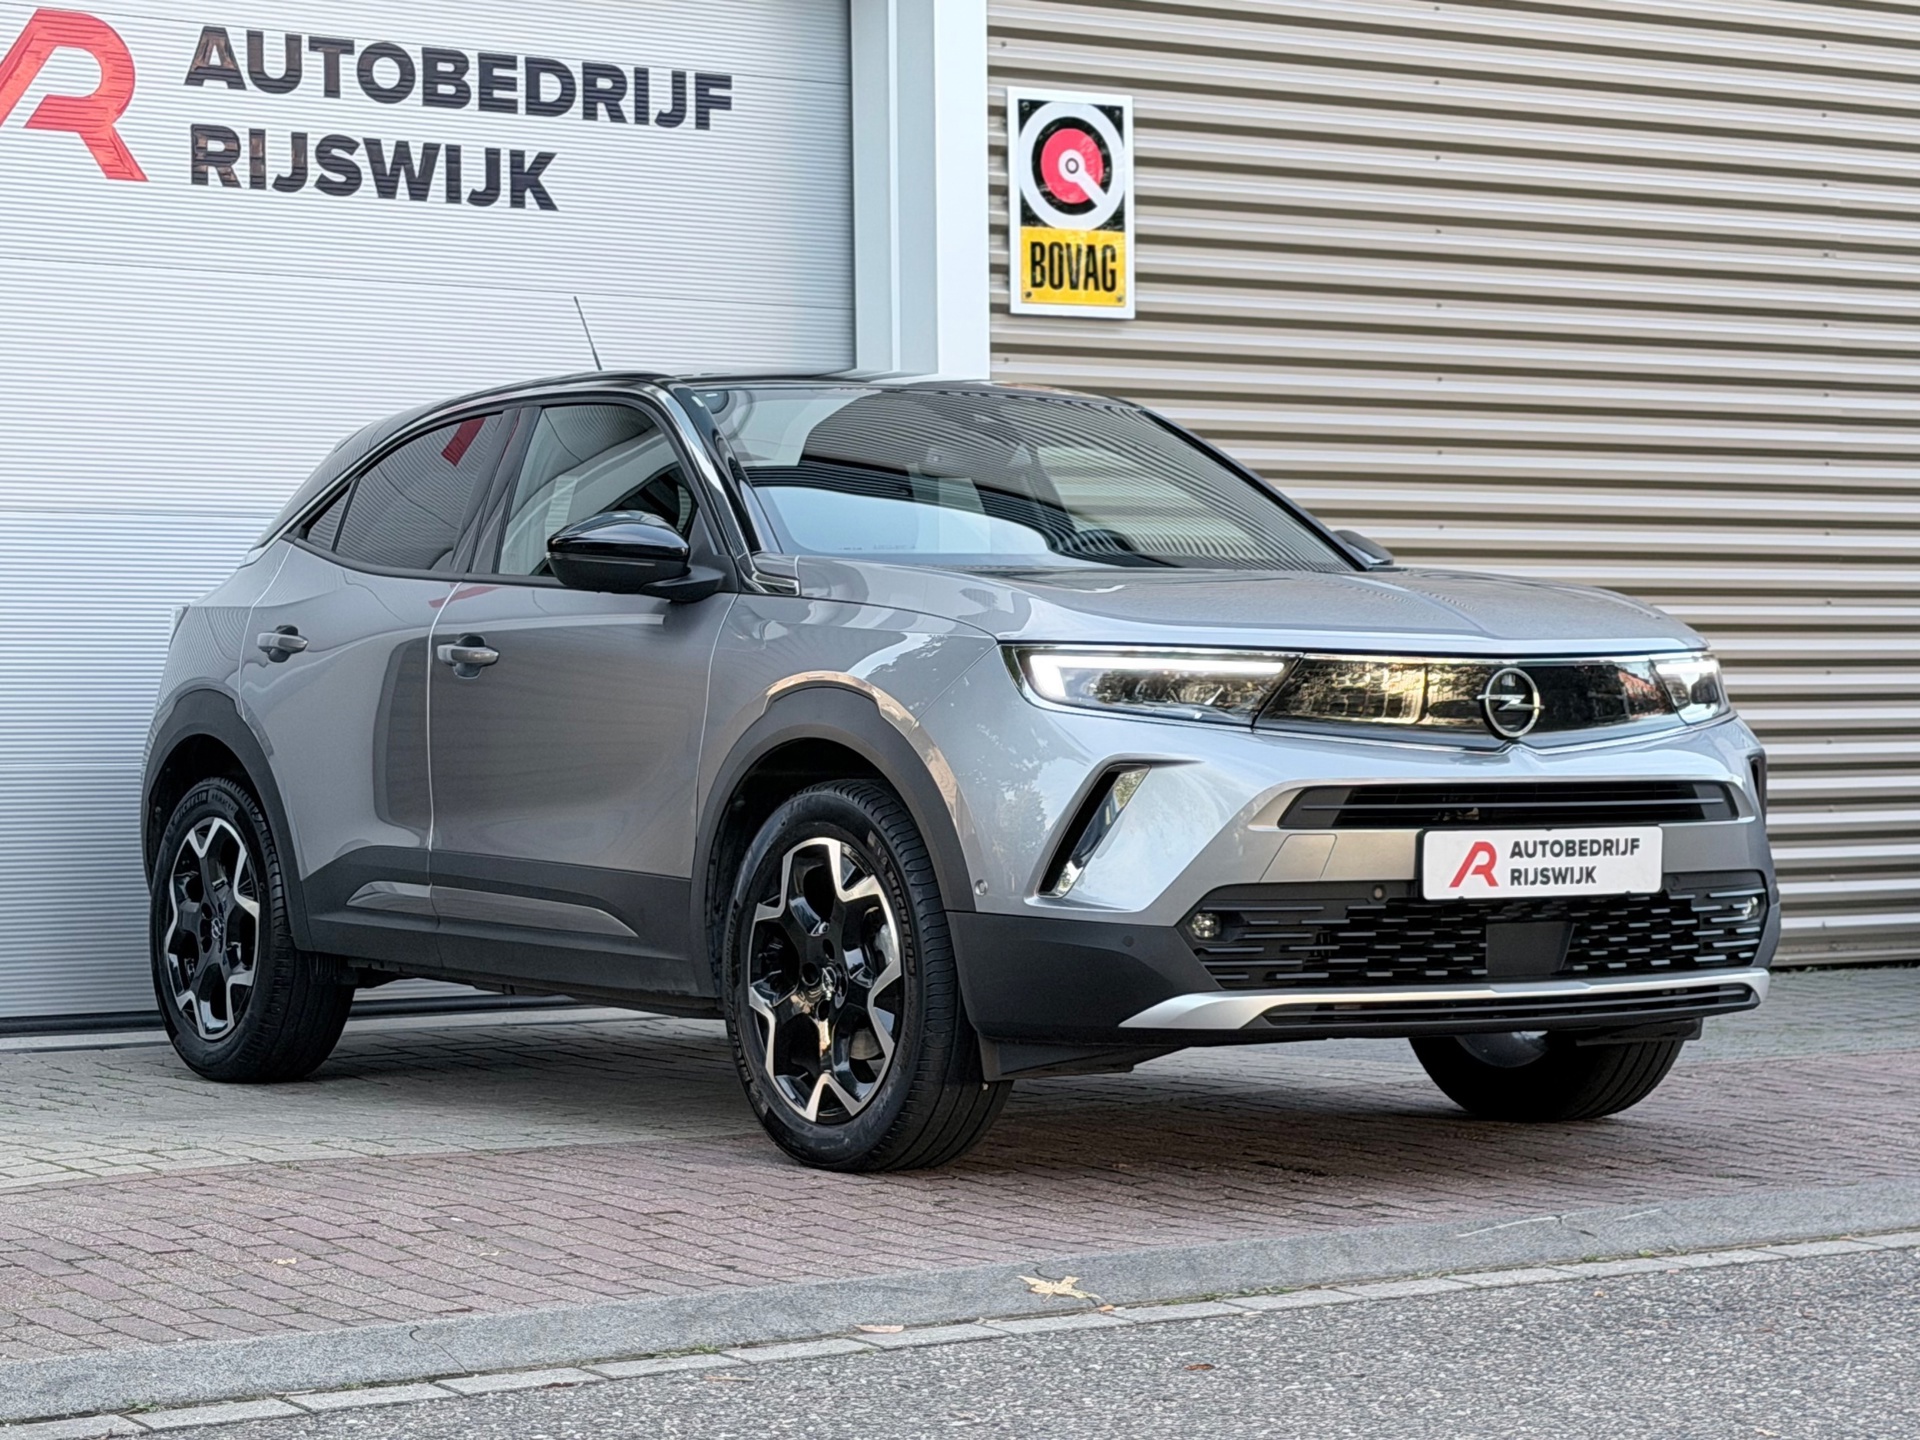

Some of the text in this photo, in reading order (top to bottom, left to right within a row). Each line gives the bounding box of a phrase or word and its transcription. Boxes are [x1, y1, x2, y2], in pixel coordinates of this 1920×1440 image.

[185, 26, 732, 130] AUTOBEDRIJF
[191, 124, 559, 211] RIJSWIJK
[1030, 242, 1116, 292] BOVAG
[1510, 838, 1640, 859] AUTOBEDRIJF
[1510, 867, 1597, 886] RIJSWIJK
